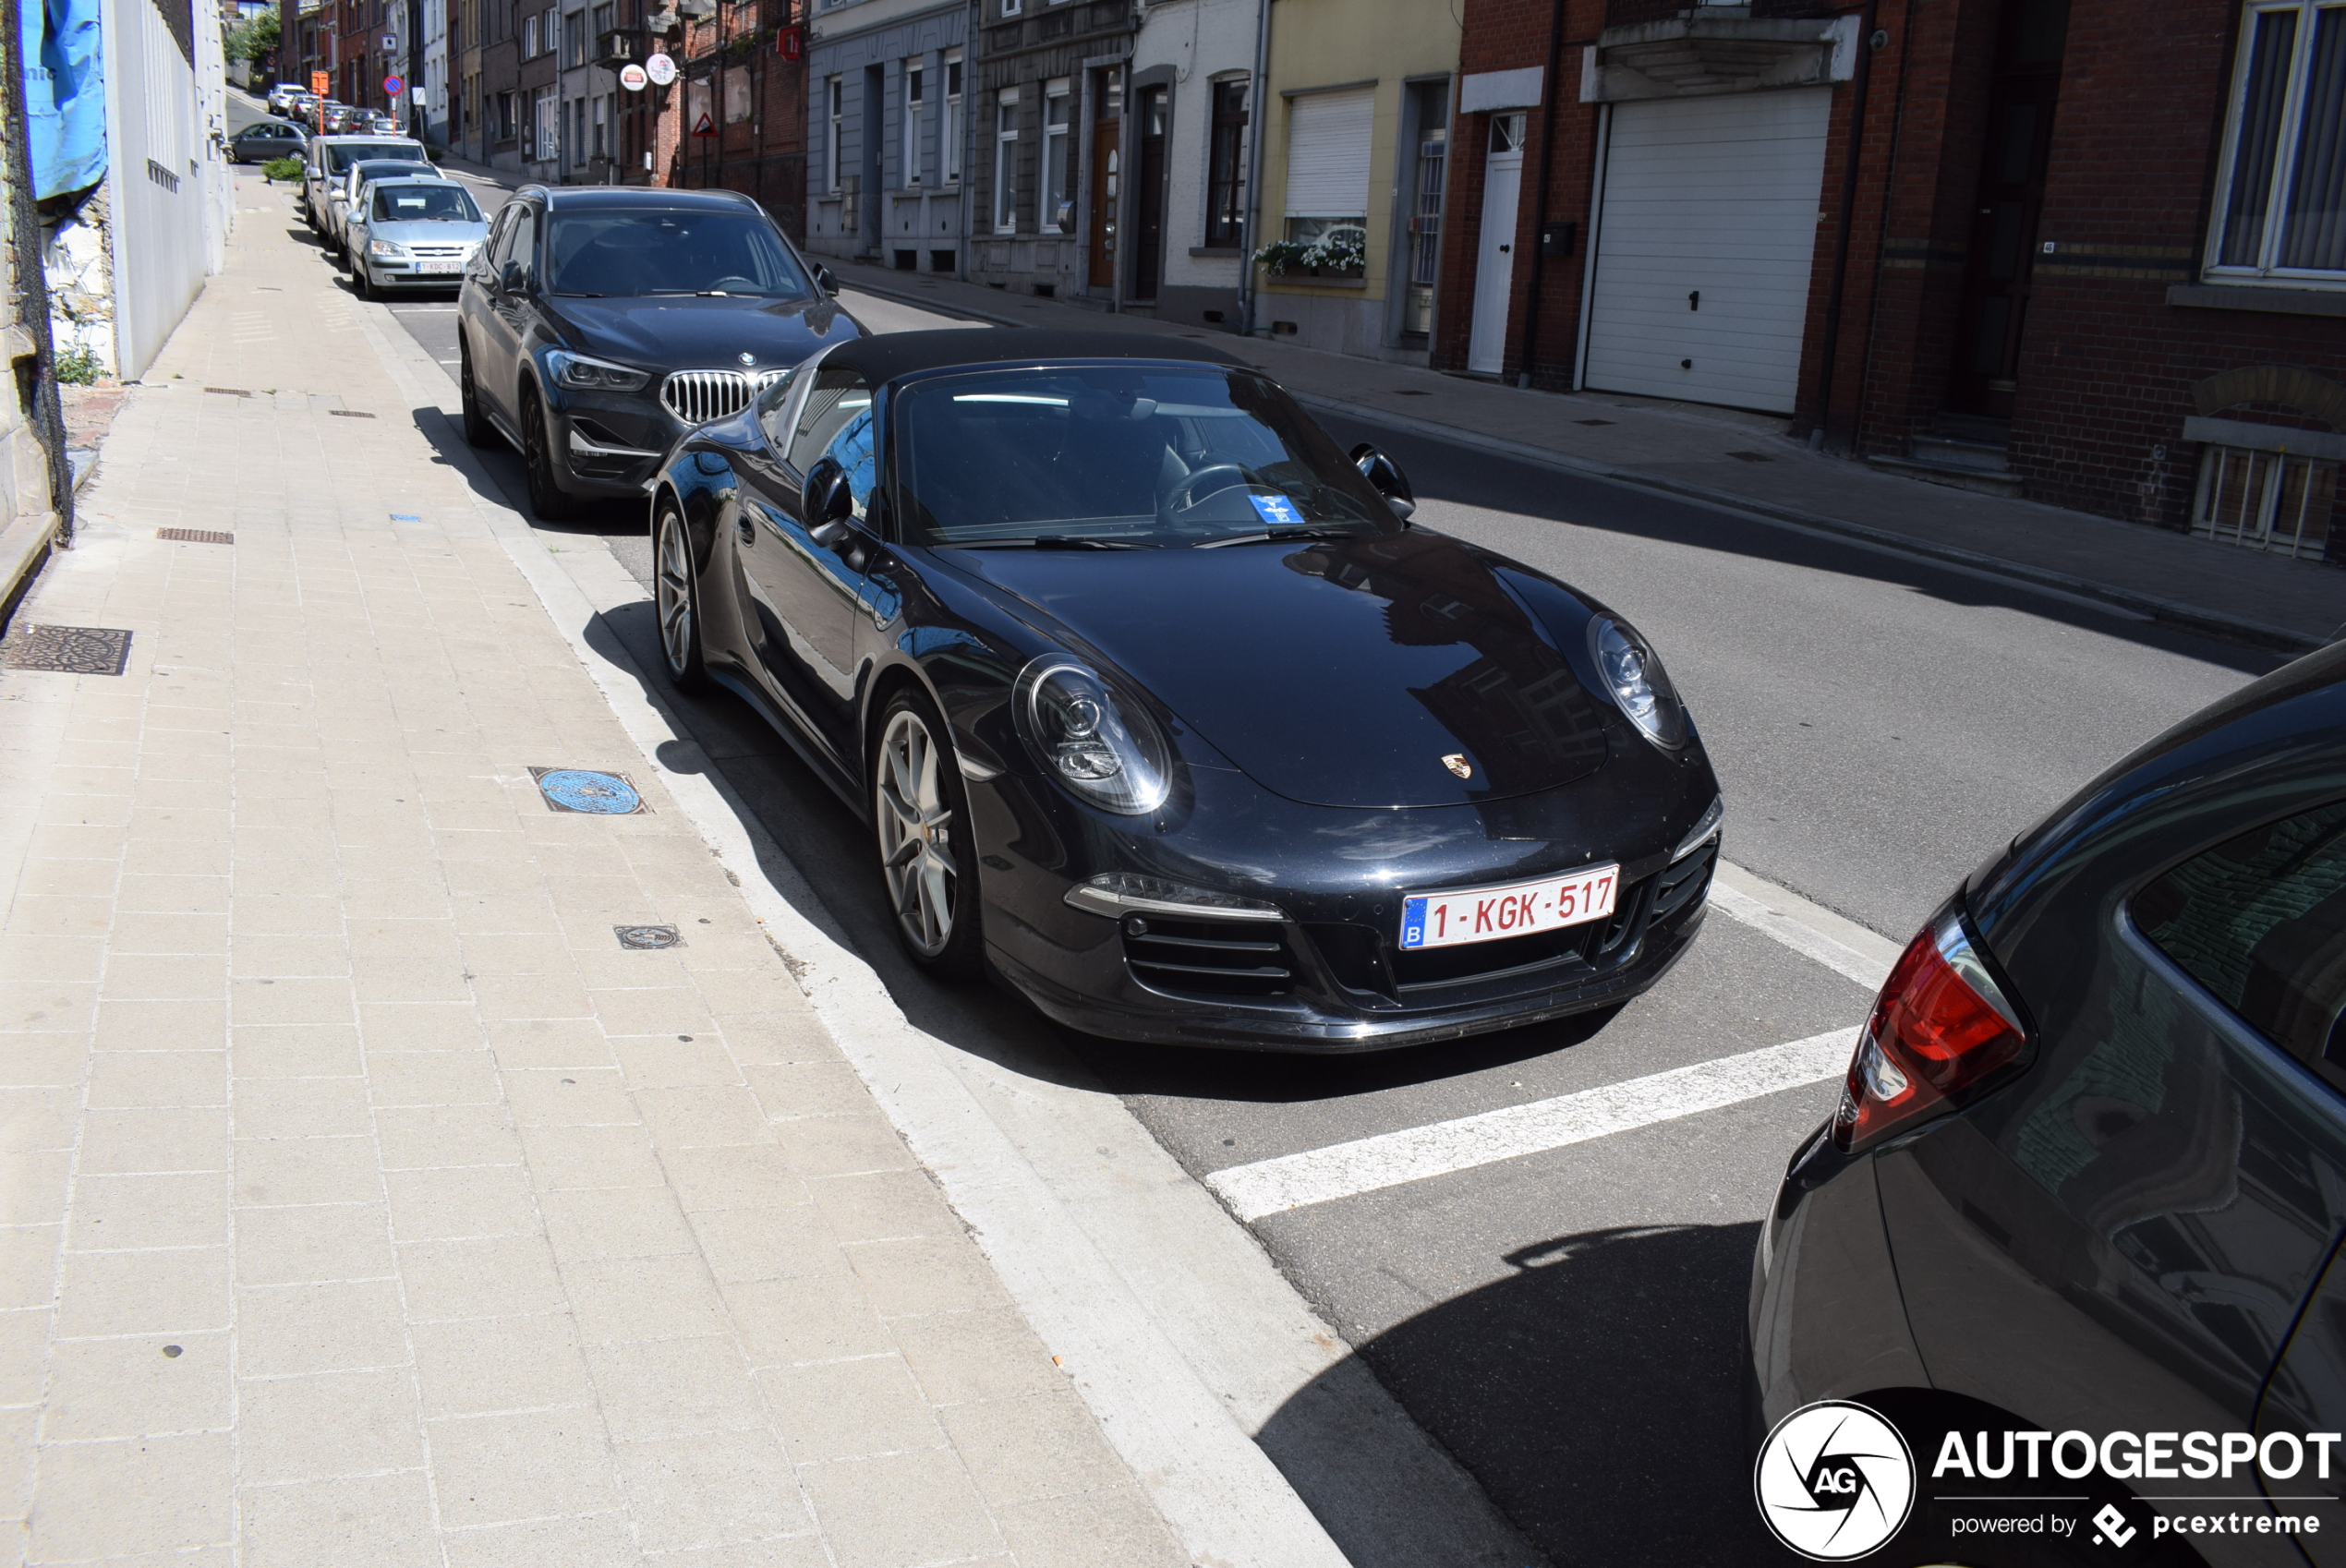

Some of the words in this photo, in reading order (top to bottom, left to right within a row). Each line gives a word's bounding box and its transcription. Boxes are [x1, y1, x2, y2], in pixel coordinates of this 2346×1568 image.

[24, 67, 57, 81] nic
[1433, 875, 1613, 938] 1-KGK-517
[1407, 926, 1421, 943] B
